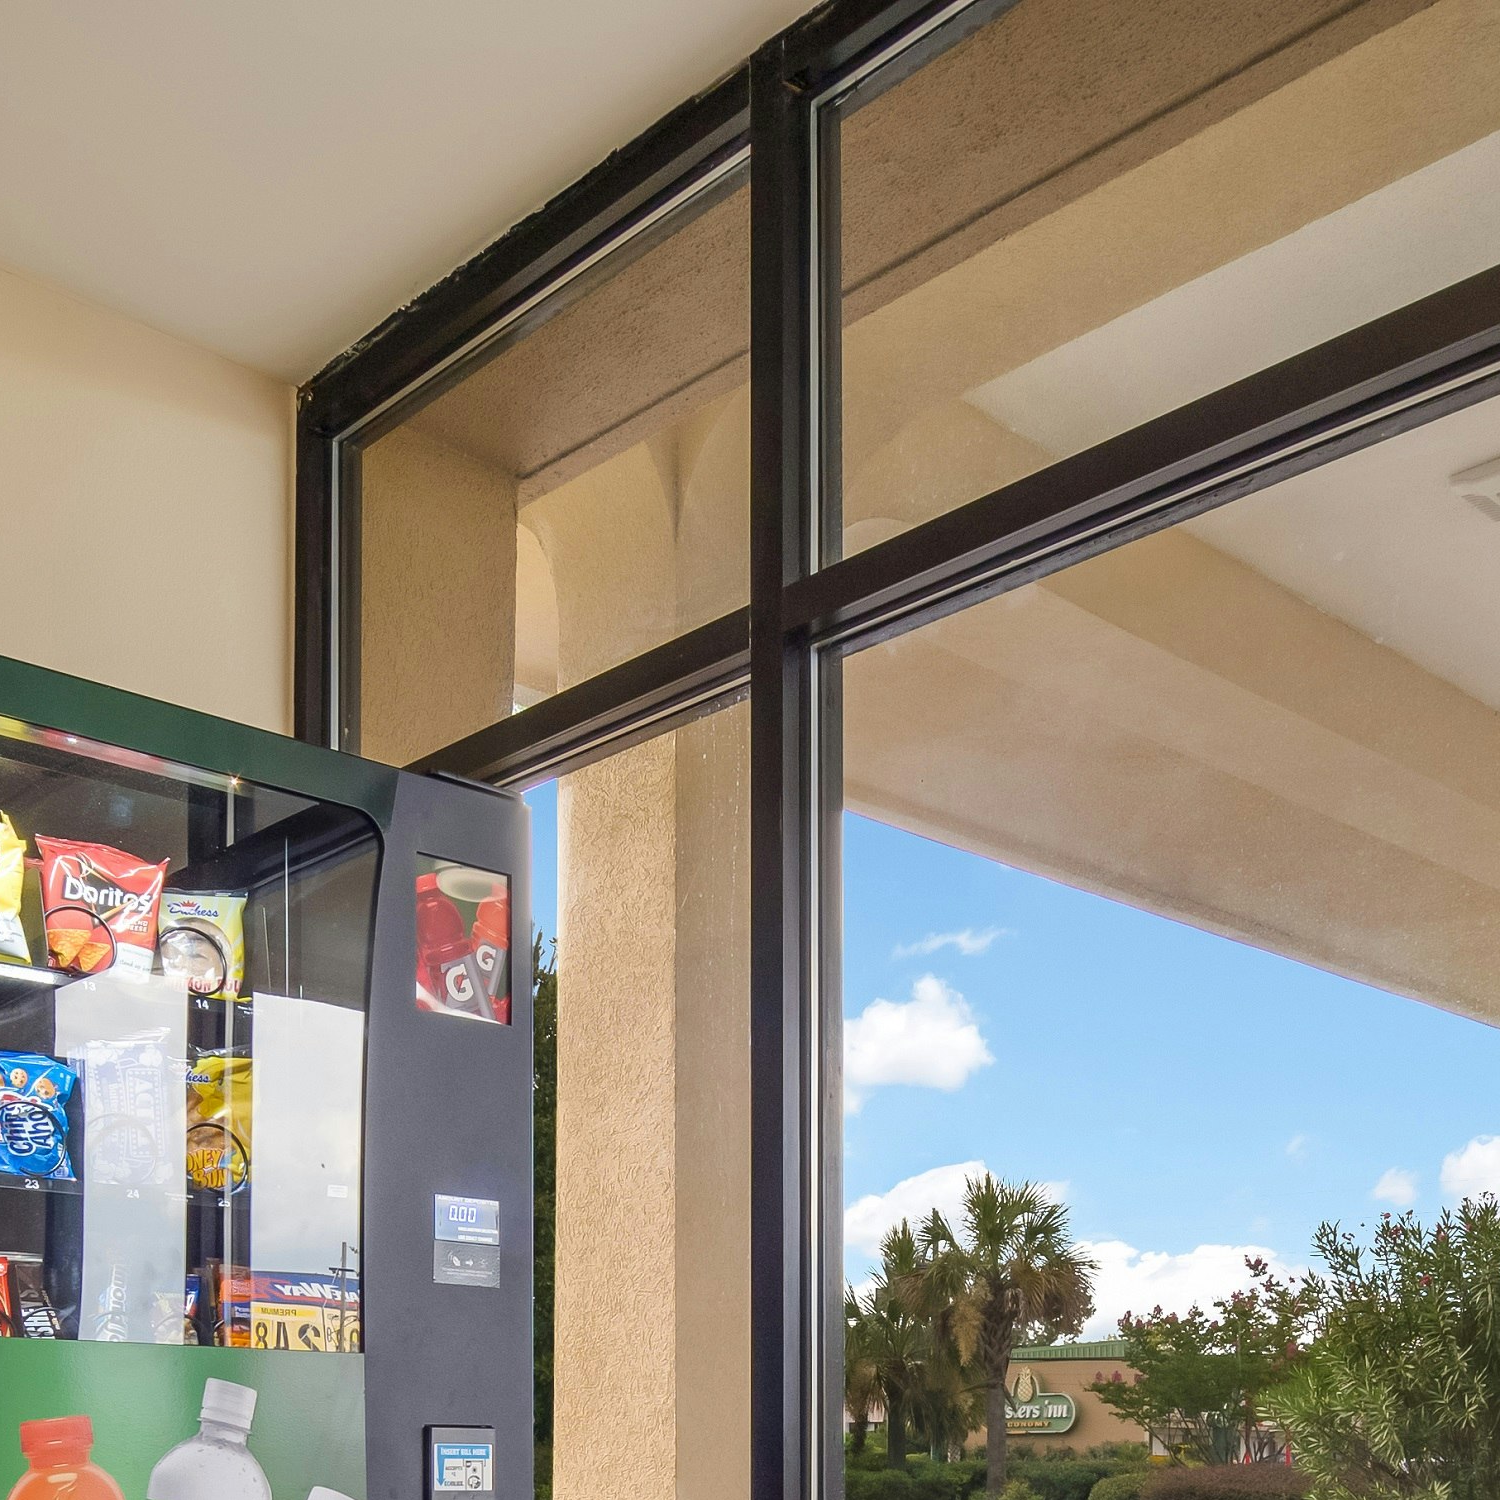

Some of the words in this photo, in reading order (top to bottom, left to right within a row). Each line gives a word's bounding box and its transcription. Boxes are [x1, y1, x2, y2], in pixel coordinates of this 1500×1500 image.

[63, 874, 152, 914] Doritos
[167, 903, 220, 918] Duchess
[476, 944, 497, 972] G
[83, 980, 97, 992] 13
[445, 963, 474, 1002] G
[195, 998, 210, 1010] 14
[4, 1104, 33, 1155] Chips
[24, 1178, 40, 1190] 23
[126, 1188, 141, 1199] 24
